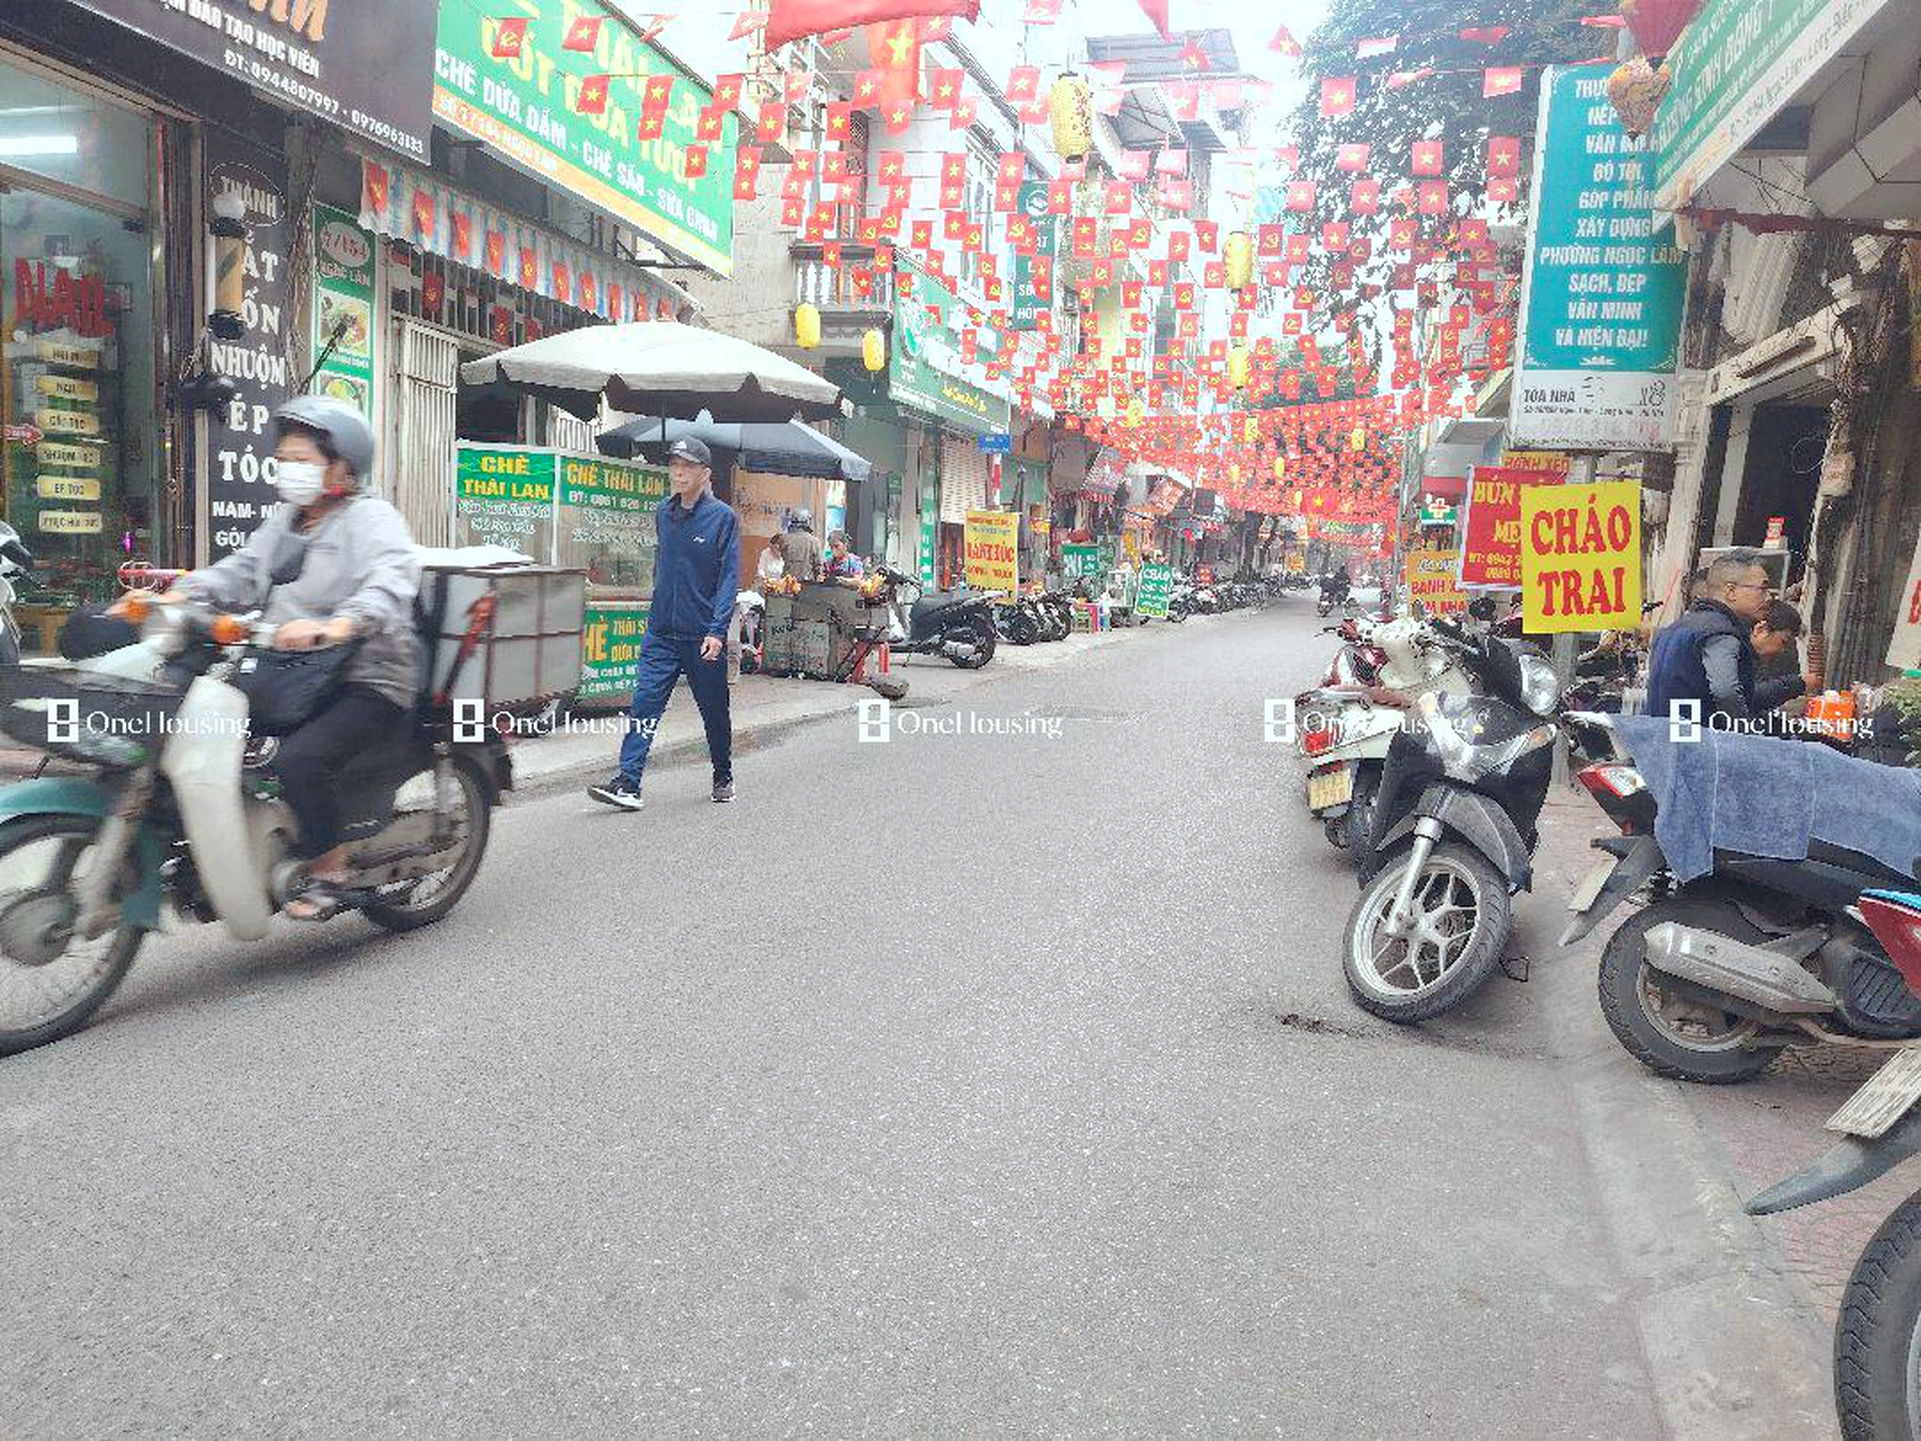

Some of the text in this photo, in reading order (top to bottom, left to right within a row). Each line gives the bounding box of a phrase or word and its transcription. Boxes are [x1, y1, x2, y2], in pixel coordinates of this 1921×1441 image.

[223, 14, 254, 45] TẠO
[256, 29, 287, 61] HỌC
[224, 49, 250, 73] ĐT:
[435, 48, 477, 96] CHÈ
[1575, 215, 1605, 238] XÂY
[1604, 246, 1646, 268] NGỌC
[1567, 299, 1642, 321] VĂN MINH
[1555, 326, 1575, 346] VÀ
[1577, 325, 1613, 351] HIỆN
[210, 343, 287, 390] NHUỘM
[218, 444, 278, 485] TÓC
[480, 454, 530, 475] CHÈ
[512, 482, 550, 499] LAN
[1474, 474, 1516, 506] BÚN
[1530, 492, 1632, 556] CHÁO
[1536, 567, 1627, 617] TRAI
[584, 614, 609, 661] HÈ
